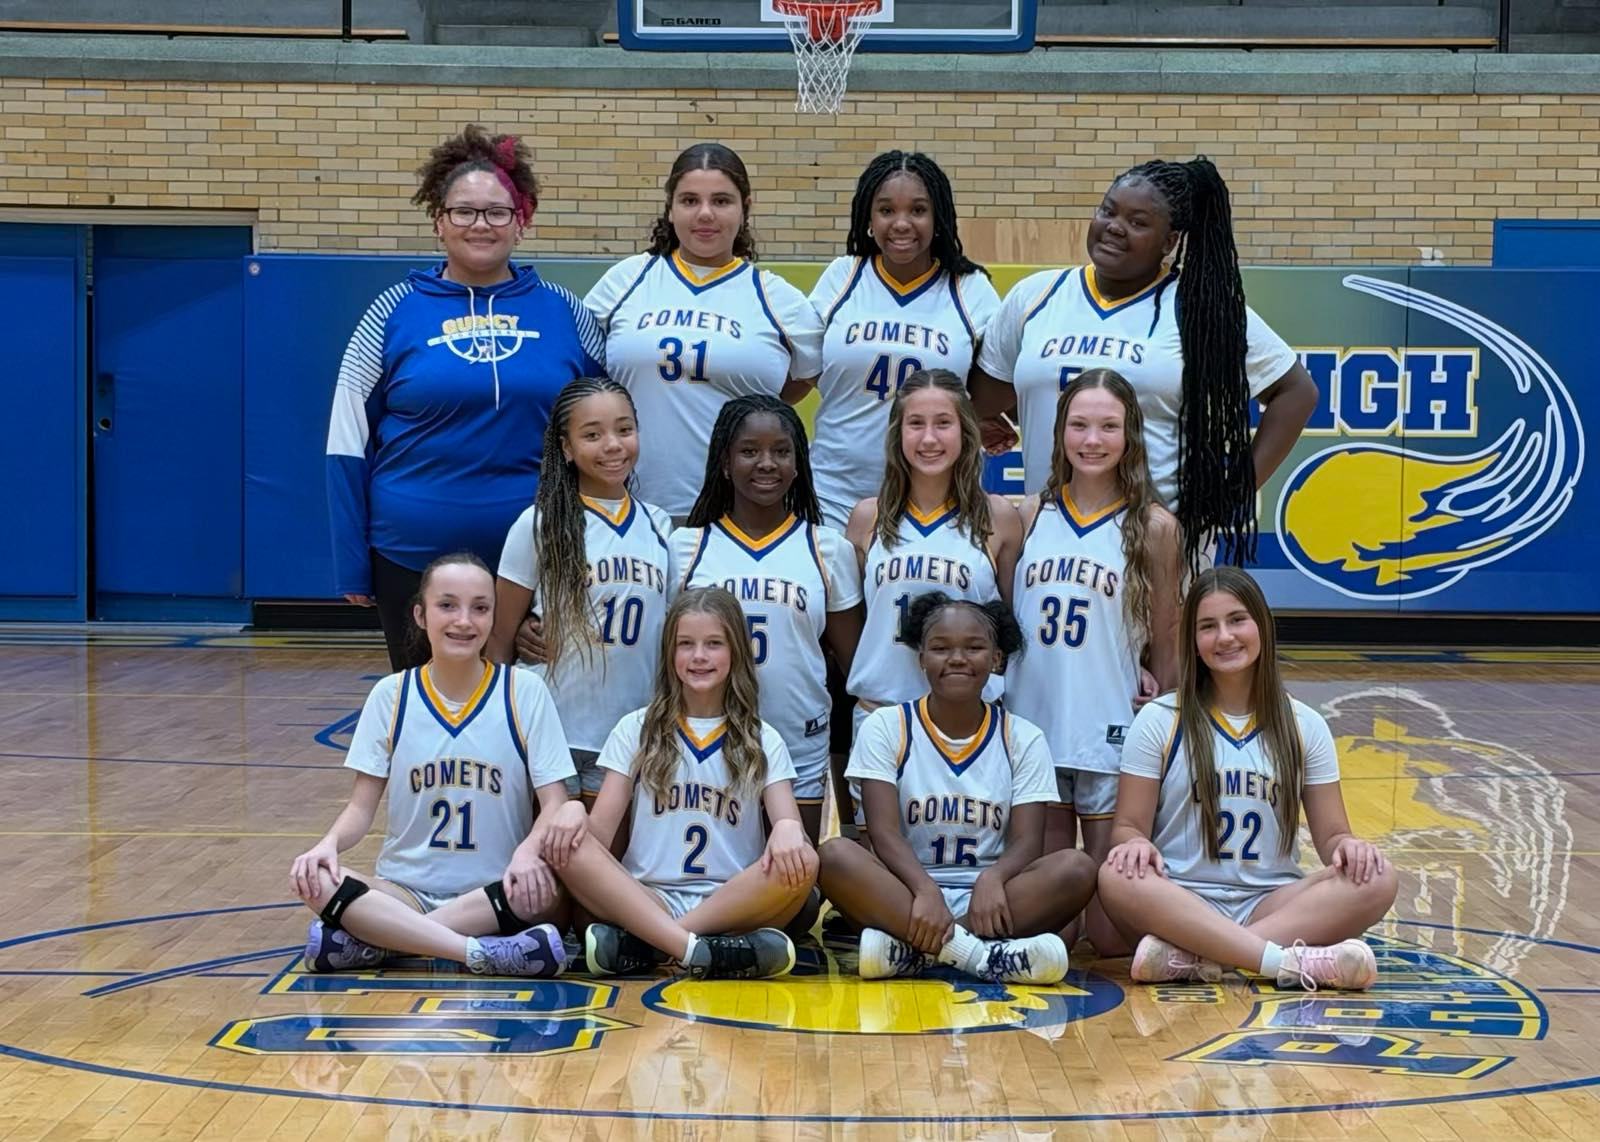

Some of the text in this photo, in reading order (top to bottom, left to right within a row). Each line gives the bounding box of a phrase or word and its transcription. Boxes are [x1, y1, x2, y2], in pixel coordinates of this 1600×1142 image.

[441, 314, 520, 335] QUNCY
[637, 308, 742, 340] COMETS
[845, 320, 950, 356] COMETS
[656, 336, 711, 384] 31
[1041, 336, 1145, 365] COMETS
[1250, 346, 1480, 438] IGH
[875, 555, 971, 591] COMETS
[1025, 555, 1118, 598] COMETS
[709, 577, 808, 613] OMETS
[601, 595, 644, 647] 10
[1039, 594, 1090, 649] 35
[409, 758, 502, 796] COMETS
[429, 799, 477, 850] 21
[907, 795, 1003, 832] COMETS
[683, 823, 709, 875] 2
[930, 836, 978, 868] 15
[1216, 810, 1262, 861] 22
